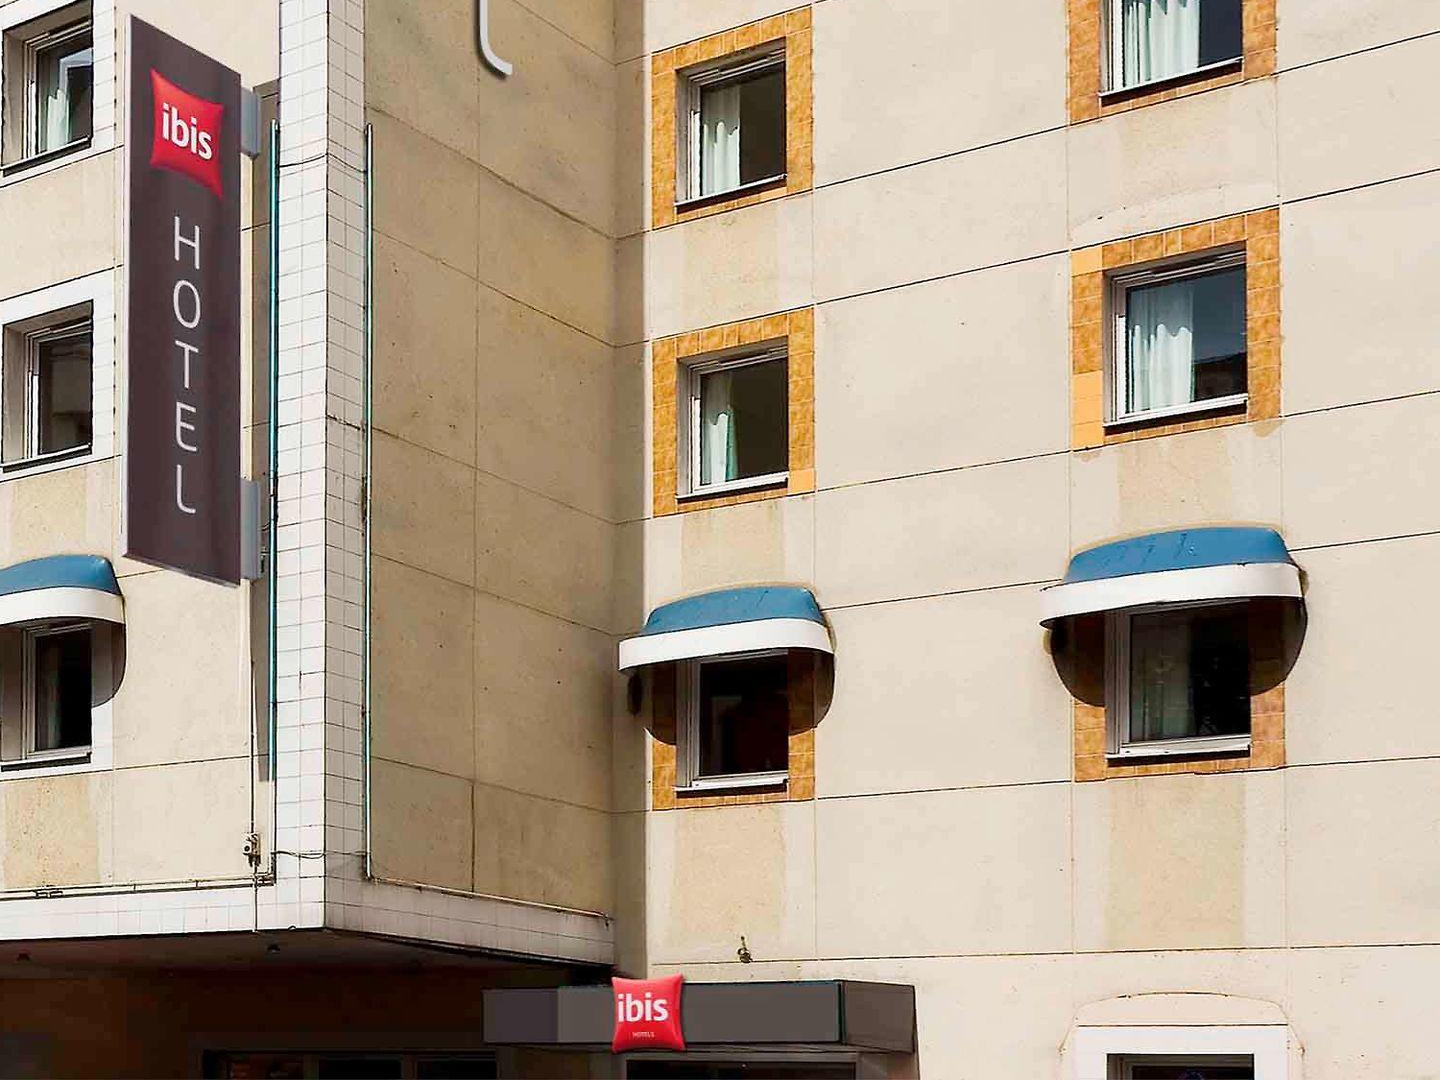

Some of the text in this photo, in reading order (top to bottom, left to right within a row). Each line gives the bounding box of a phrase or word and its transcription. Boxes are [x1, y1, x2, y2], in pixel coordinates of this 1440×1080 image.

[162, 102, 213, 161] ibis
[172, 216, 202, 515] HOTEL
[617, 992, 669, 1022] ibis
